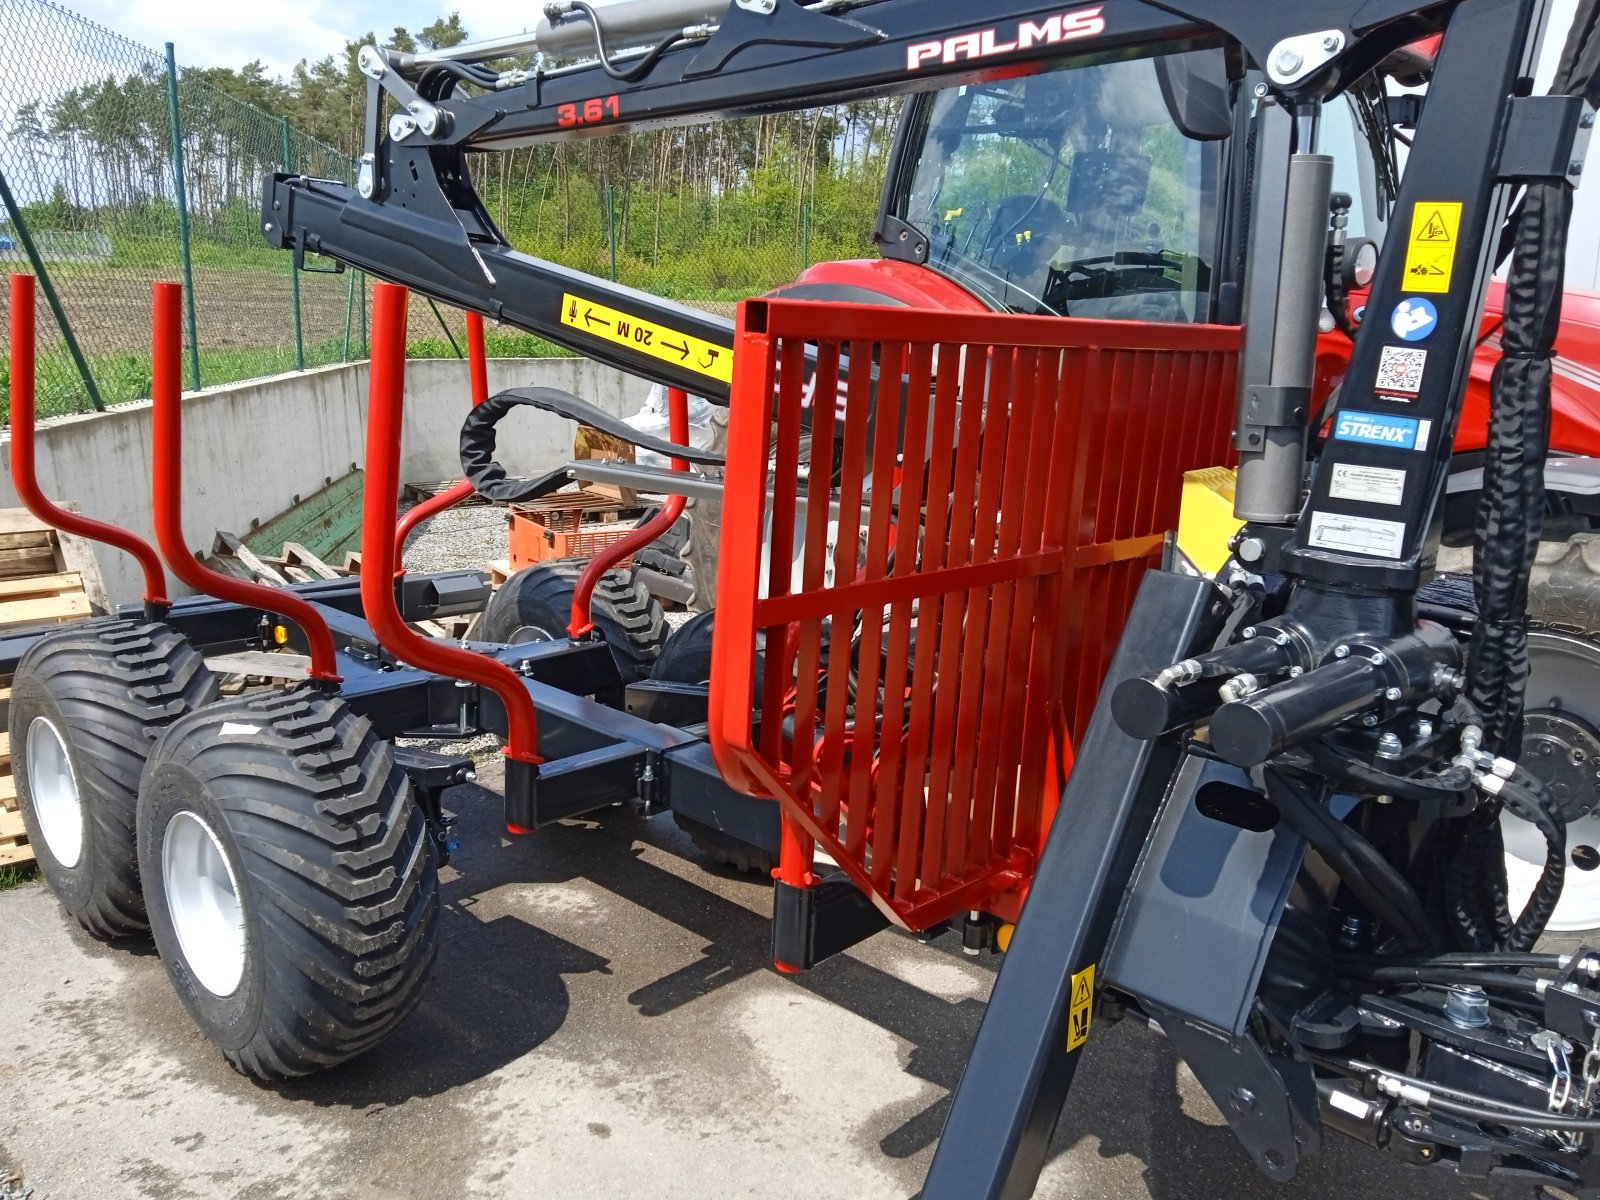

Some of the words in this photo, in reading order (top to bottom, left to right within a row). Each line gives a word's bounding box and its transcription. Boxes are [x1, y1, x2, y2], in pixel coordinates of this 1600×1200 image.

[907, 6, 1105, 71] PALMS
[557, 94, 619, 127] 3.61
[617, 320, 630, 338] M
[634, 327, 653, 346] 20
[1337, 421, 1405, 443] STRENX
[1337, 469, 1348, 478] CE
